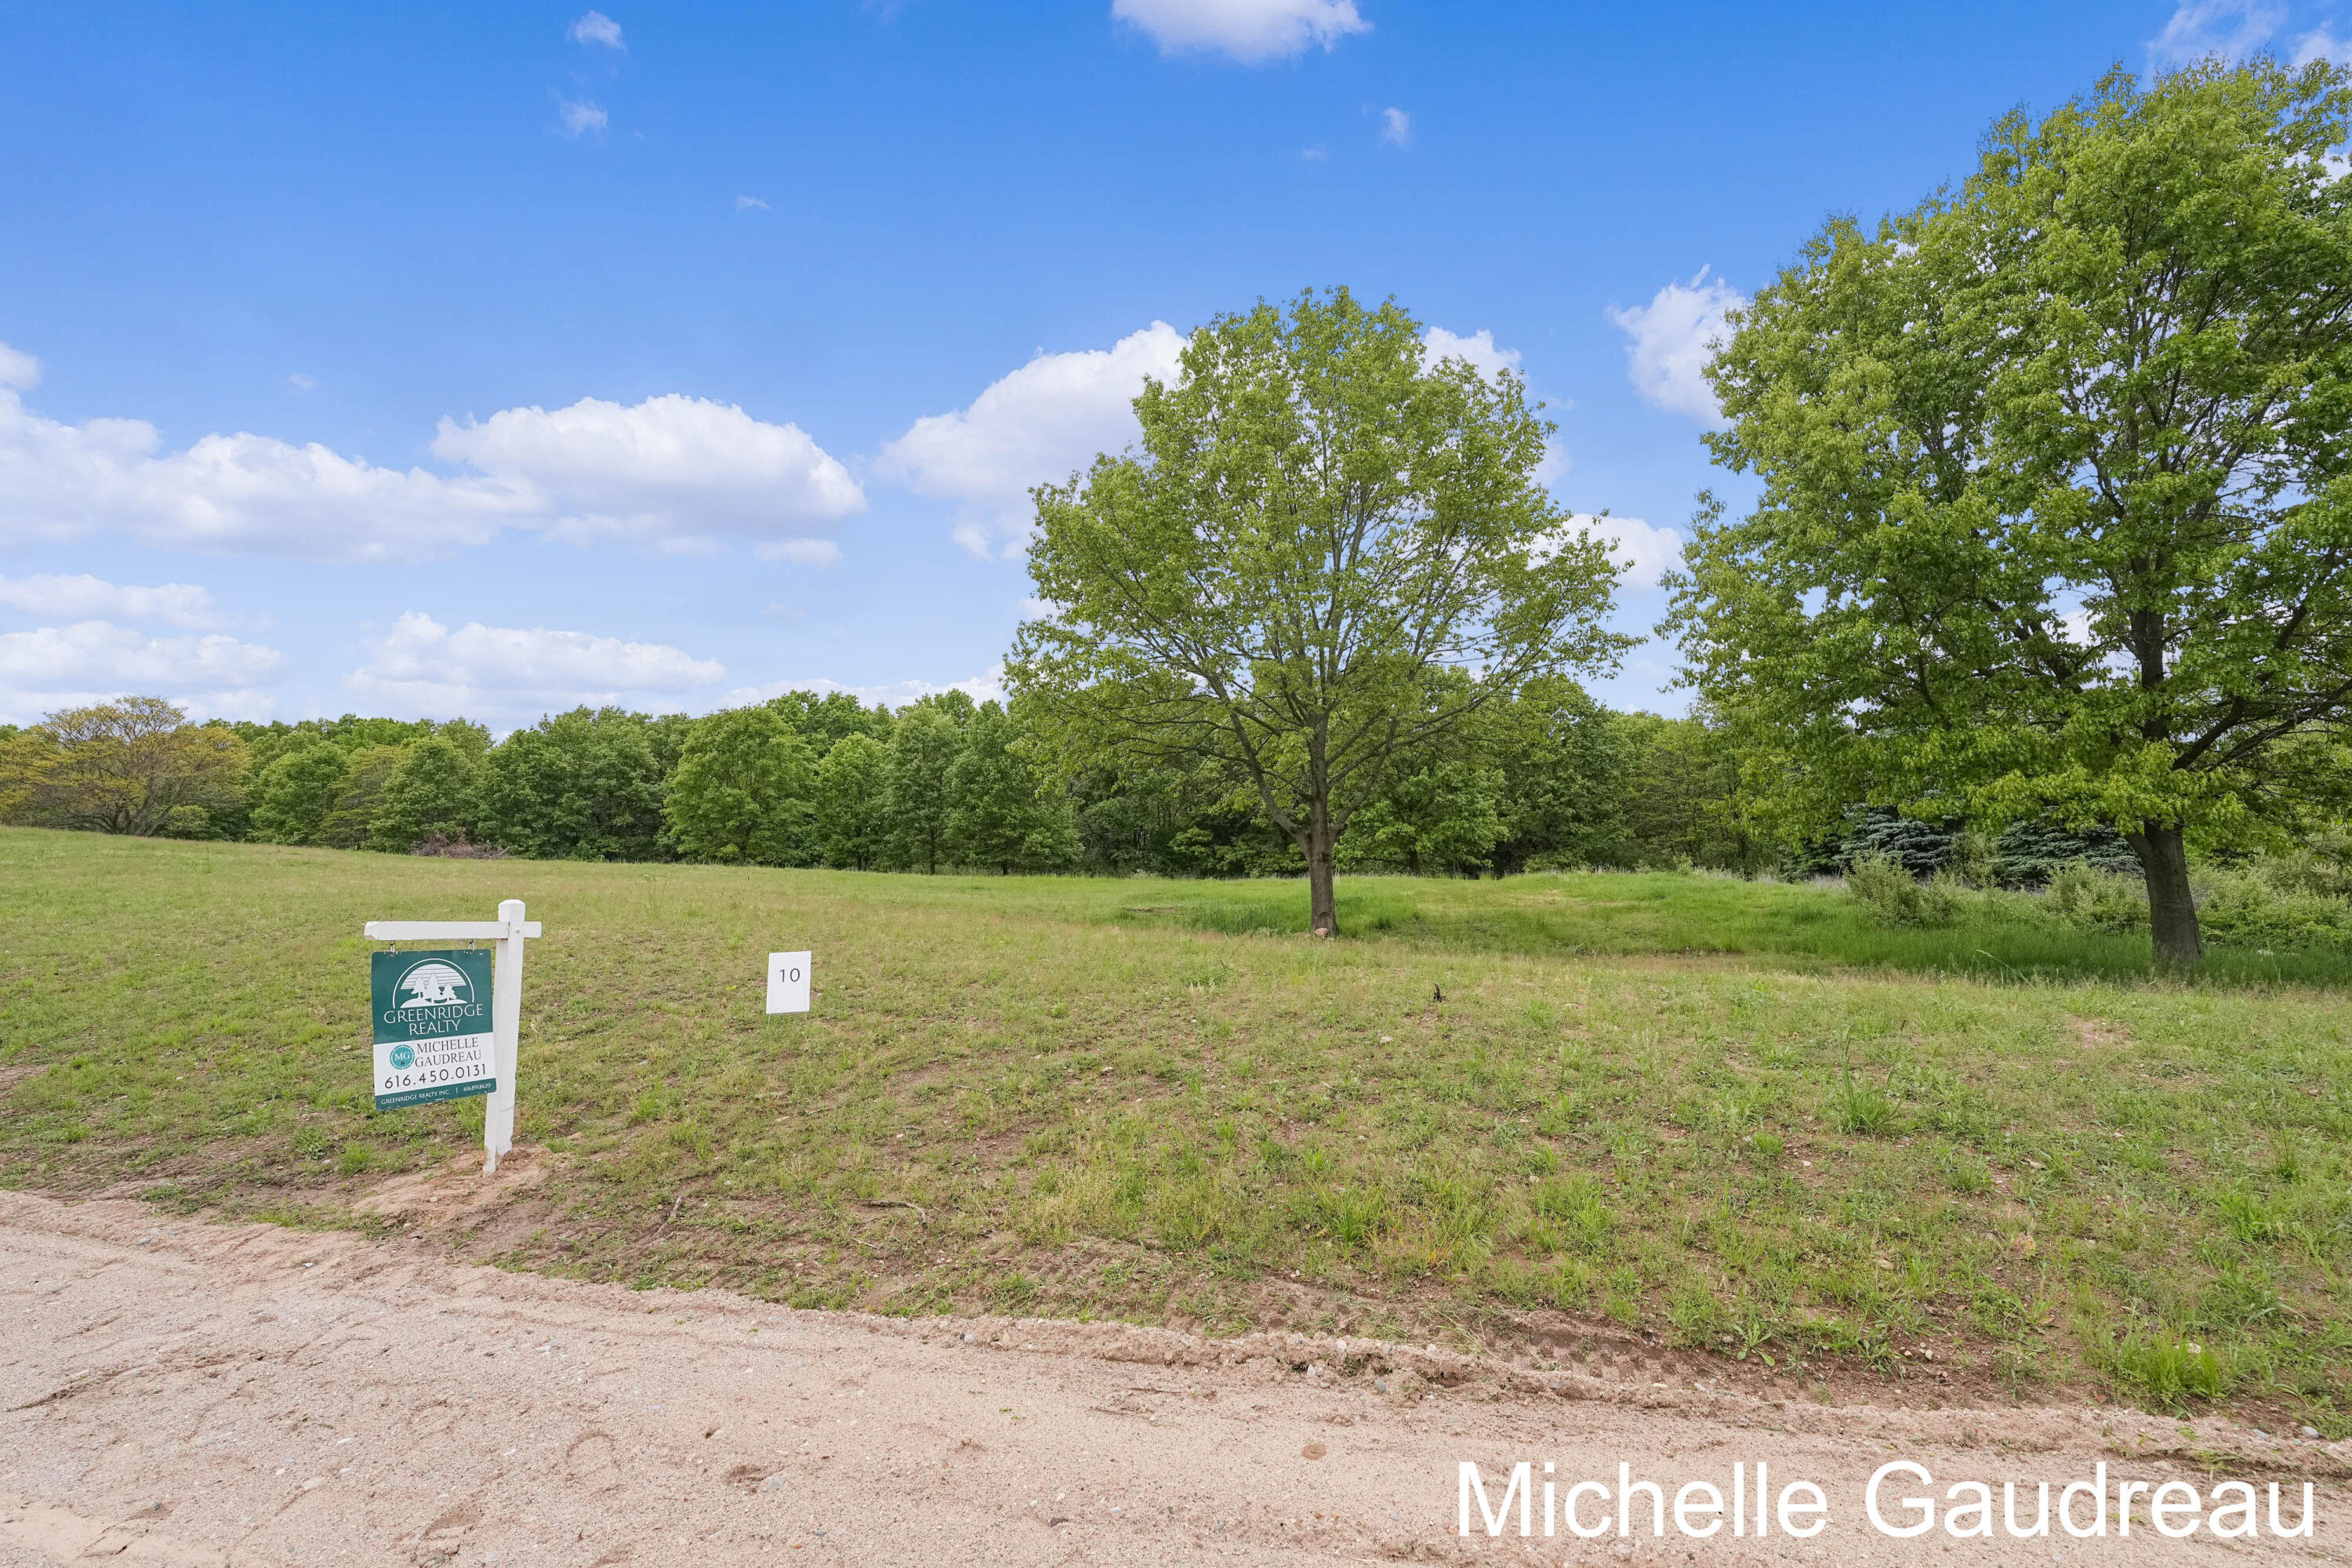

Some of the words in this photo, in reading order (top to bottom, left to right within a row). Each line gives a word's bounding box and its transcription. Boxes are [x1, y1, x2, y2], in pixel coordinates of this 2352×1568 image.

[779, 967, 800, 982] 10
[383, 1004, 484, 1024] GREENRIDGE
[409, 1019, 461, 1036] REALTY
[417, 1036, 479, 1054] MICHELLE
[394, 1051, 411, 1061] MG
[415, 1049, 481, 1068] GAUDREAU
[384, 1063, 486, 1089] 616.450.0131
[381, 1094, 418, 1105] GREENRIDGE
